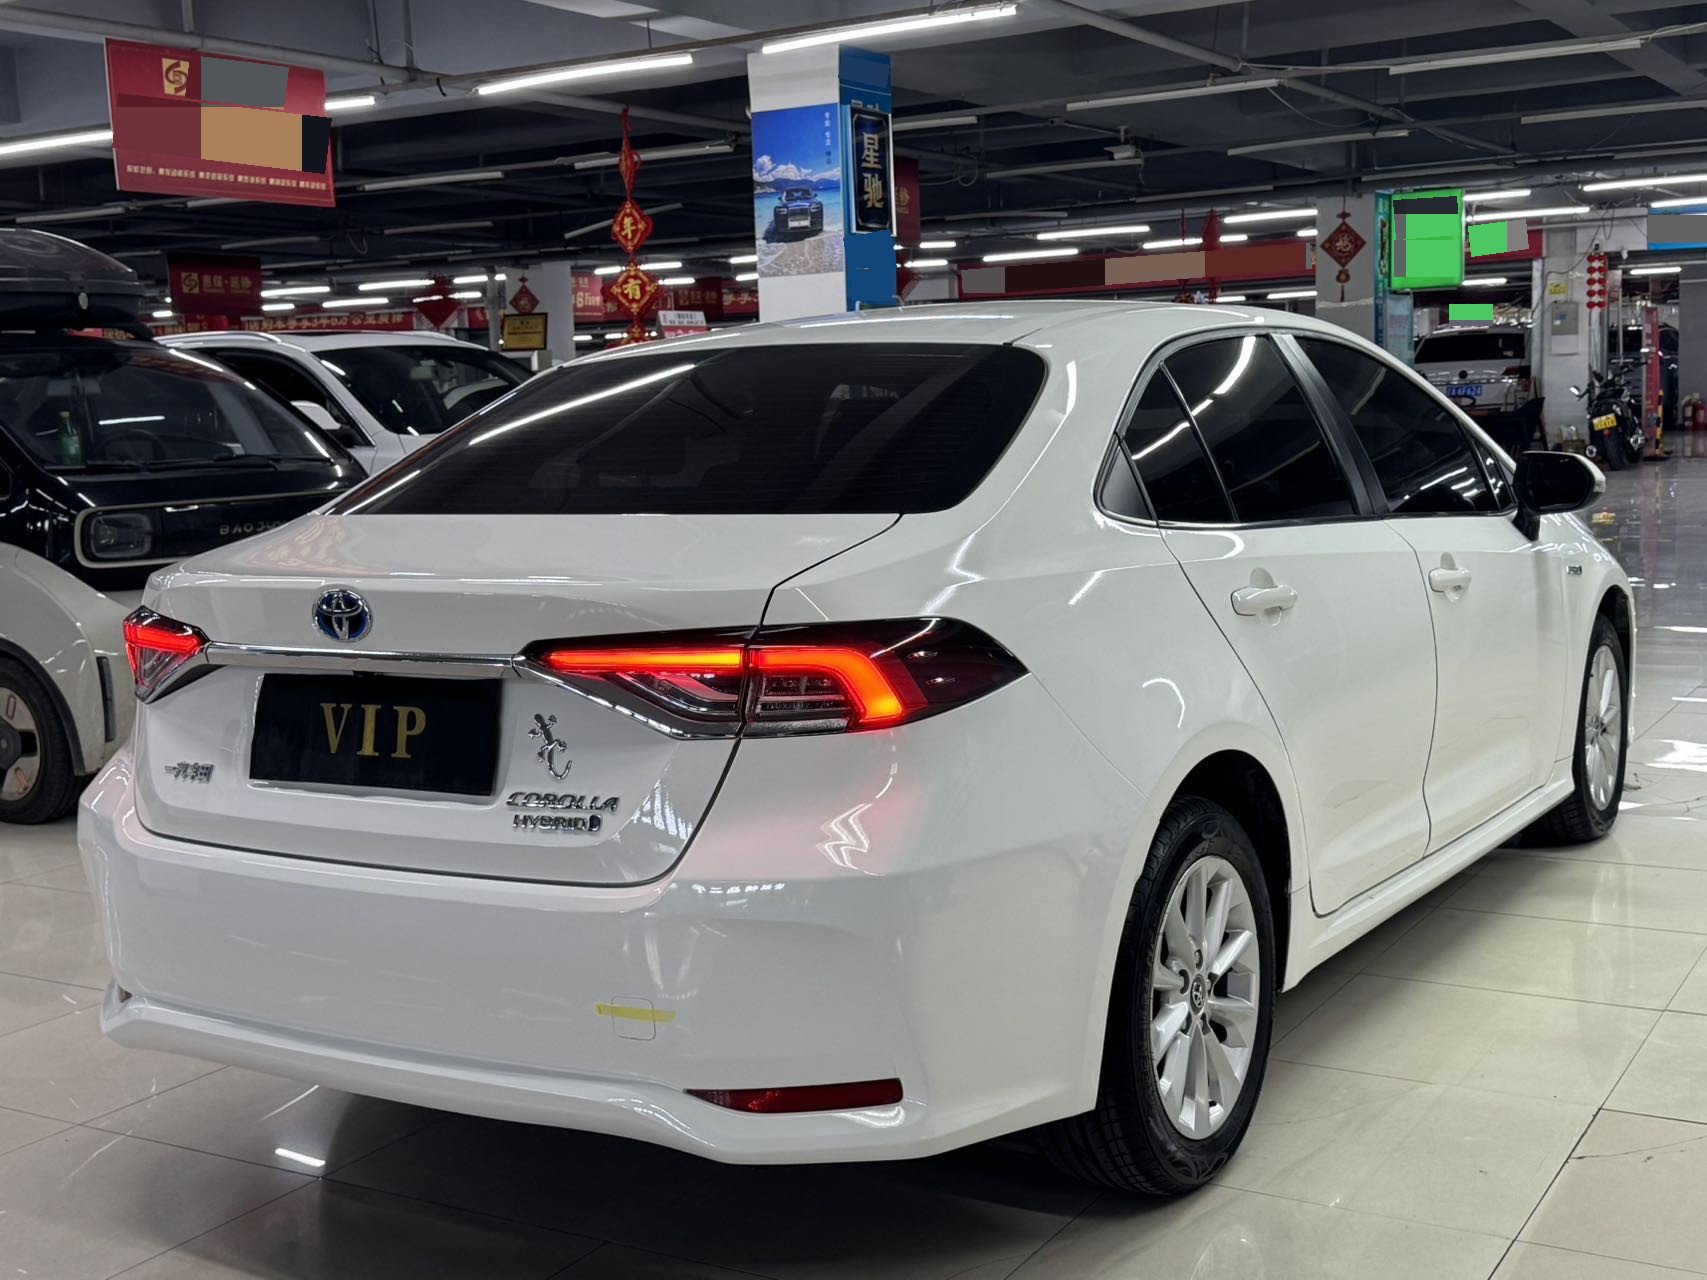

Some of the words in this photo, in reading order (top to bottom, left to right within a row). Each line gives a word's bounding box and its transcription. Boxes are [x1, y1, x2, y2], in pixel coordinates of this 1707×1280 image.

[861, 131, 885, 208] 星驰
[622, 278, 643, 300] 有
[319, 702, 427, 759] VIP
[506, 791, 620, 811] COROLLA
